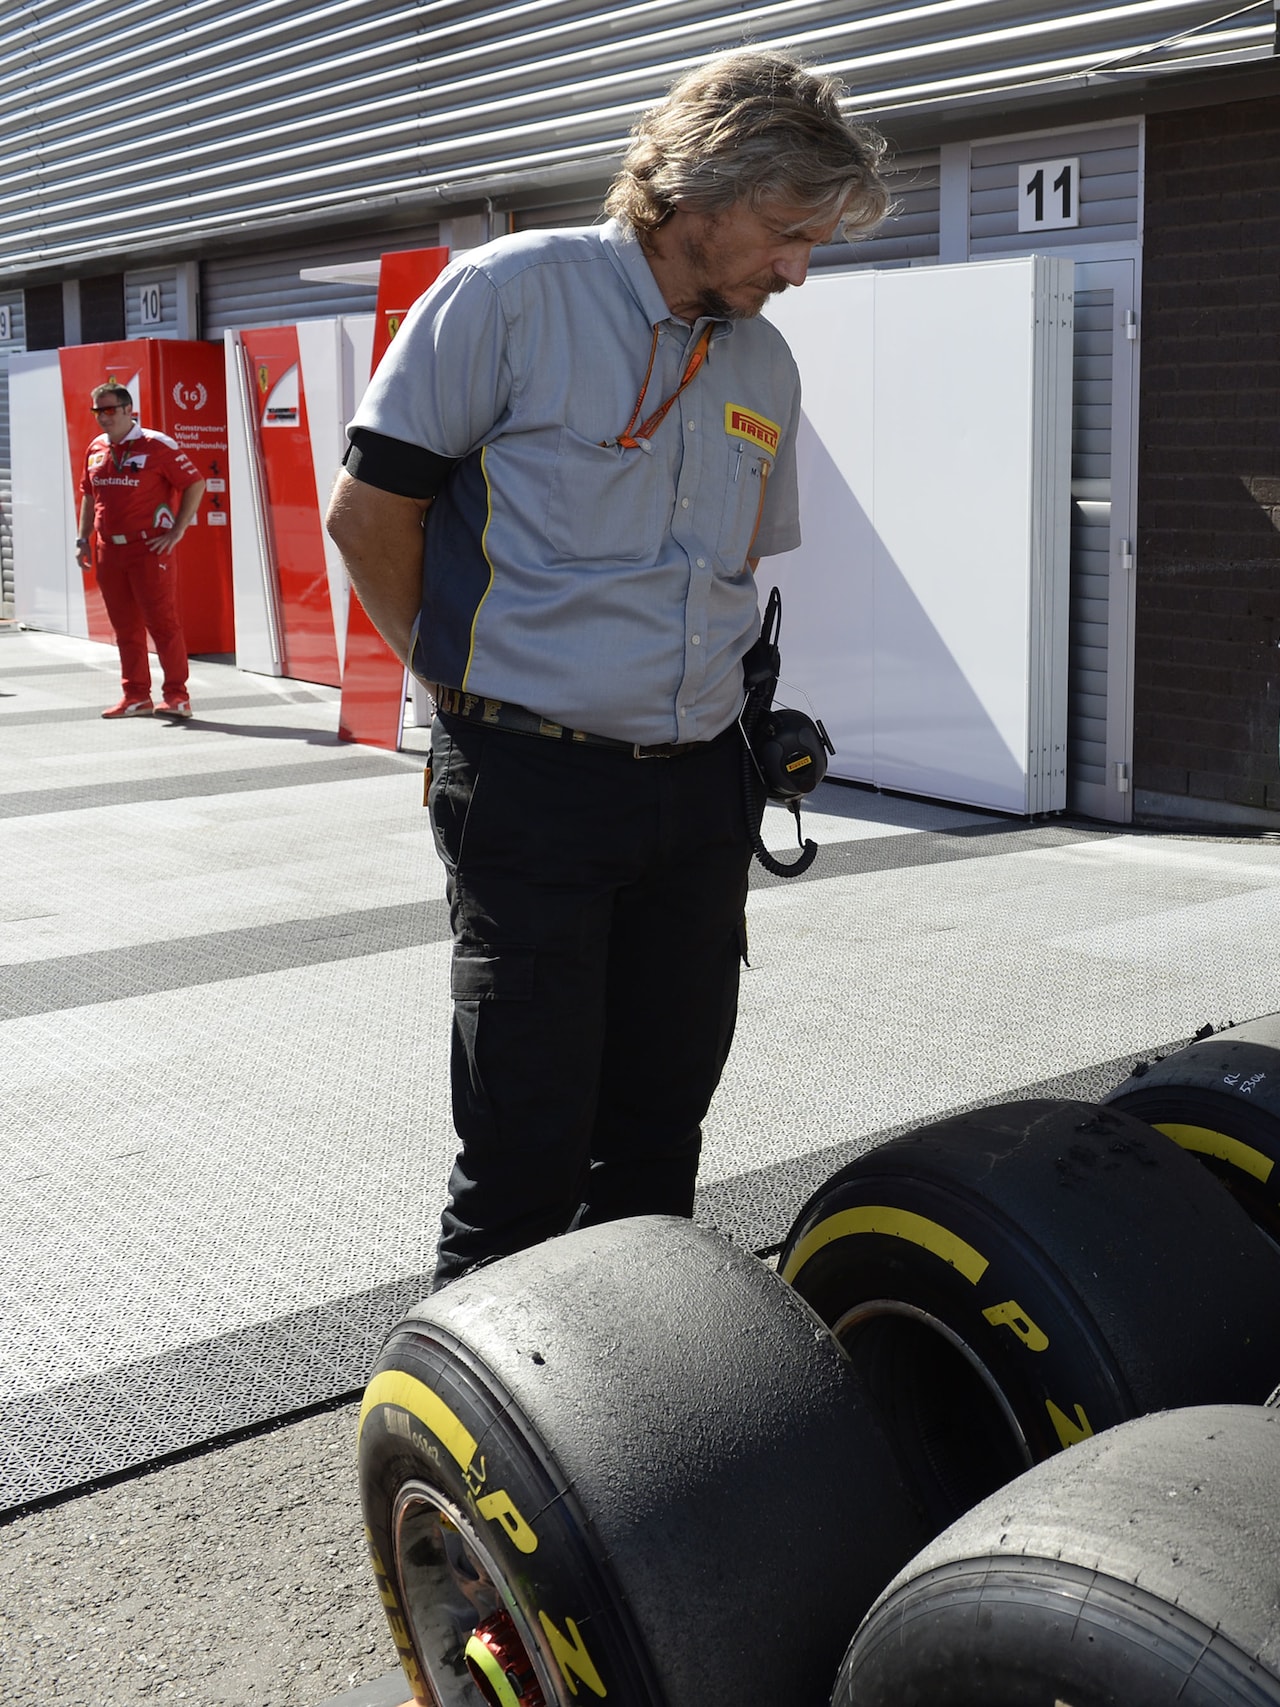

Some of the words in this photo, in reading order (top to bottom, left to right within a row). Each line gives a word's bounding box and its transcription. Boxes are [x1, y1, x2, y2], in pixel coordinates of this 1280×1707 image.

[1027, 165, 1072, 222] 11
[142, 290, 158, 319] 10
[183, 391, 198, 401] 16
[174, 432, 199, 440] World
[732, 411, 778, 449] PIRELLI
[982, 1300, 1049, 1352] P
[476, 1489, 539, 1554] P
